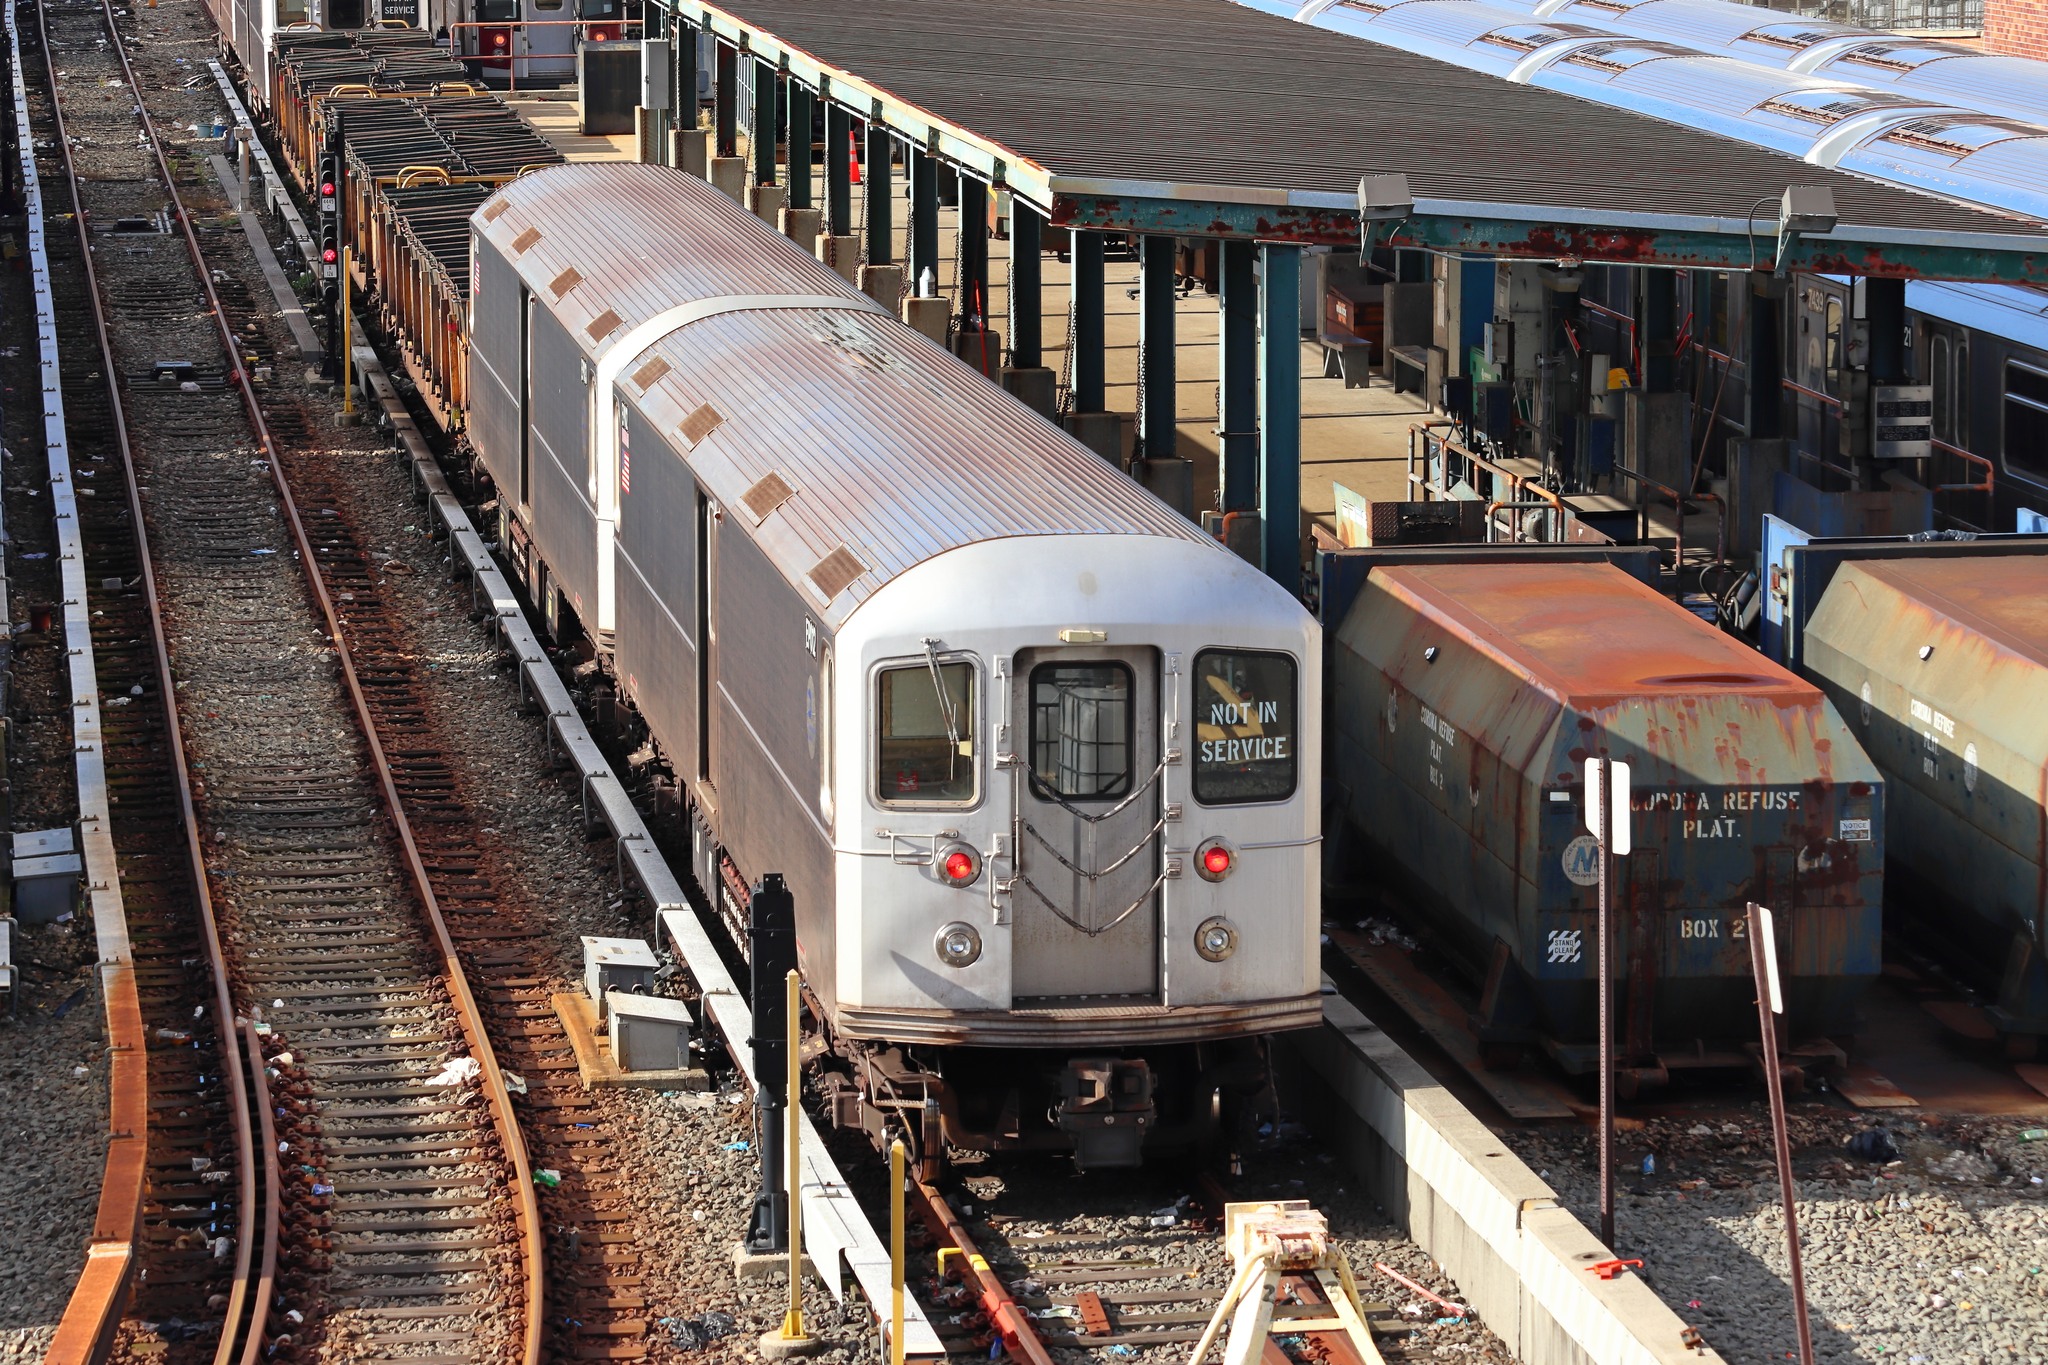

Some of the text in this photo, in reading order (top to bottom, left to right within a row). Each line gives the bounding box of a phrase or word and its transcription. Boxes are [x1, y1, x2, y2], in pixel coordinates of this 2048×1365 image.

[384, 6, 415, 14] SERVICE
[1211, 701, 1277, 725] NOT IN
[1201, 737, 1287, 762] SERVICE
[1723, 791, 1800, 811] REFUSE
[1683, 819, 1741, 838] PLAT.
[1681, 919, 1745, 939] BOX 2
